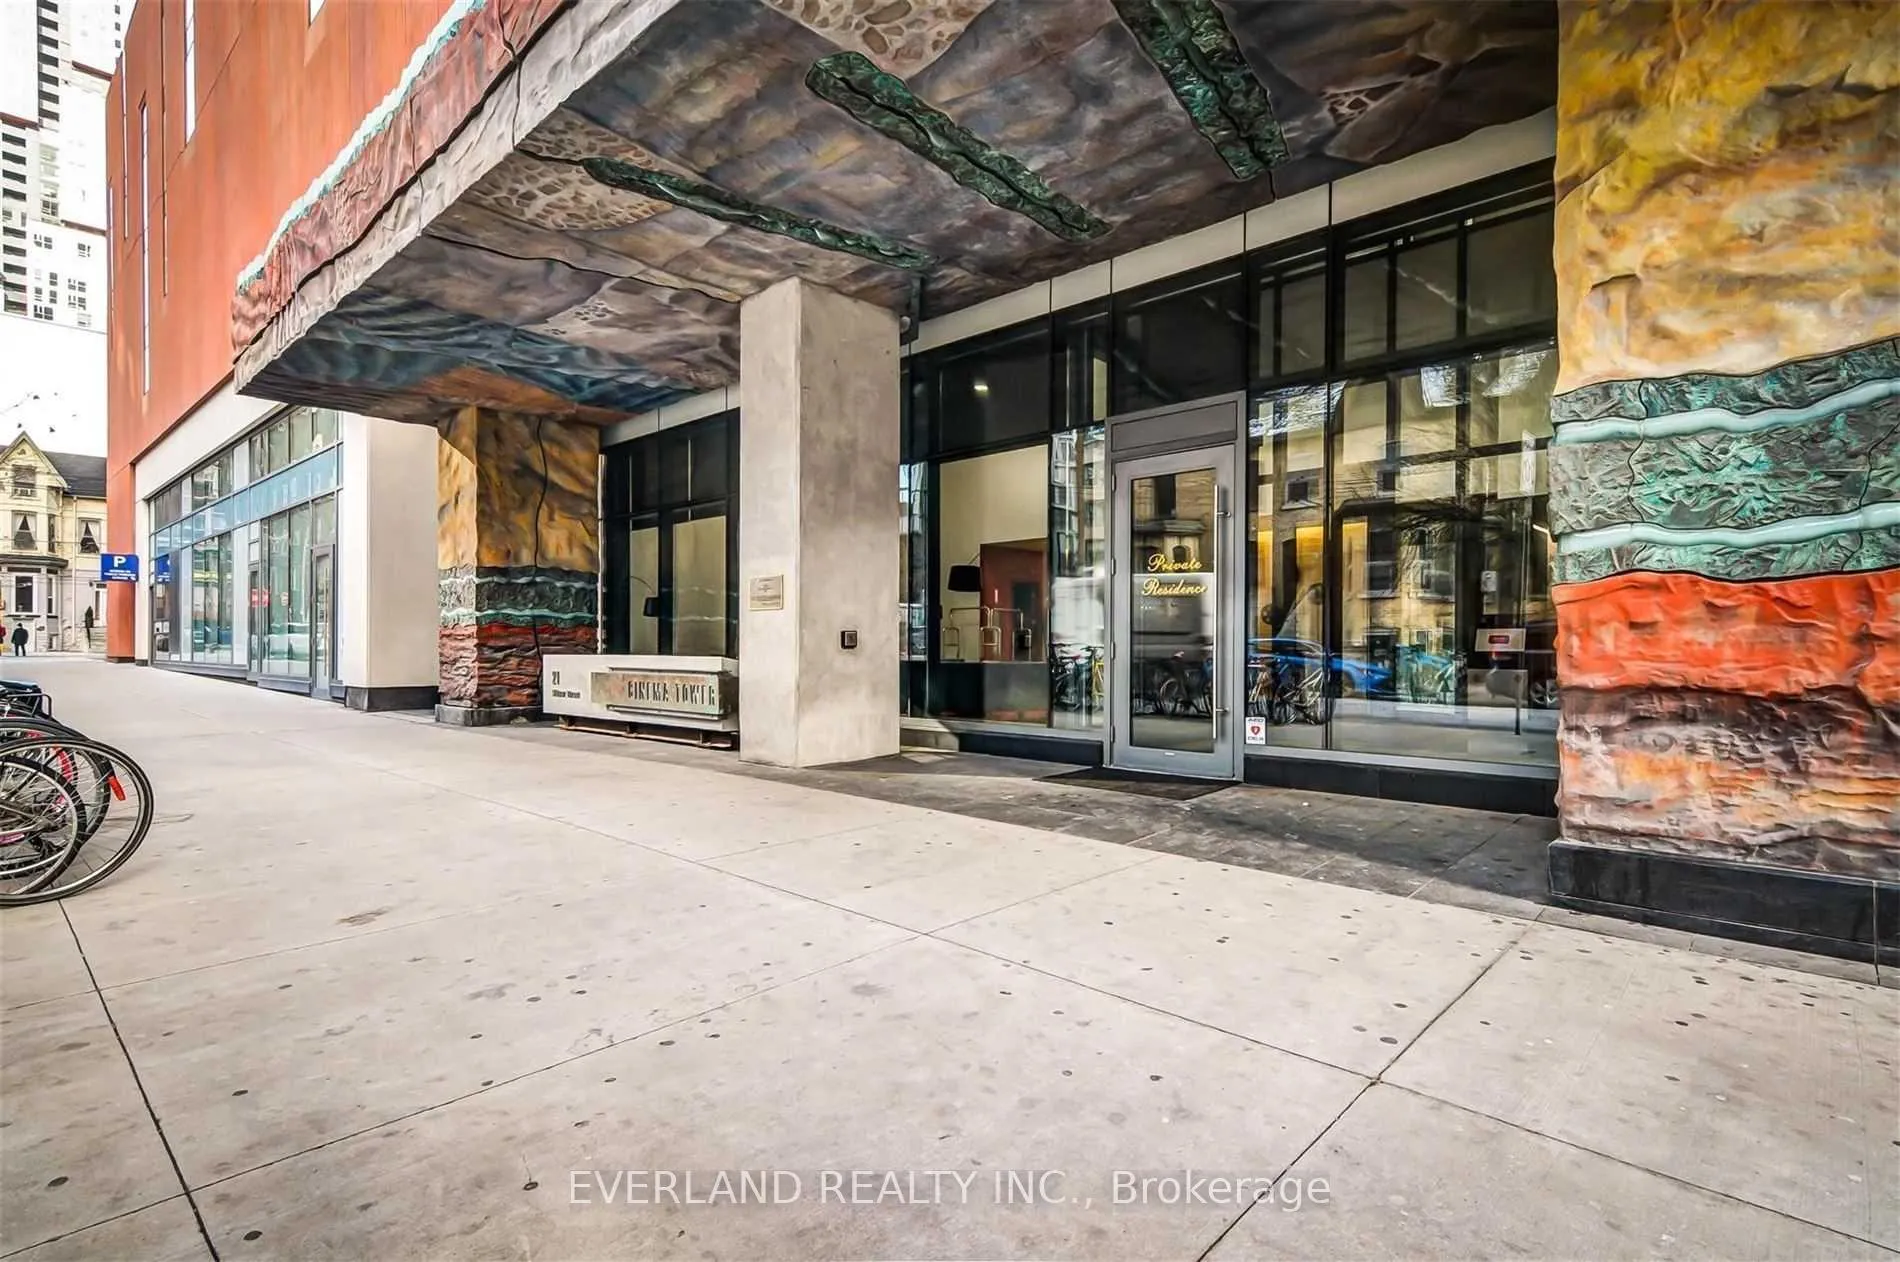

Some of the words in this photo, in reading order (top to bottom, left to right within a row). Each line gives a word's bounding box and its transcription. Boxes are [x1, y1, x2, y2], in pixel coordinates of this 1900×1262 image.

[113, 555, 127, 568] P
[1147, 553, 1202, 571] Private
[1141, 577, 1208, 596] Residence
